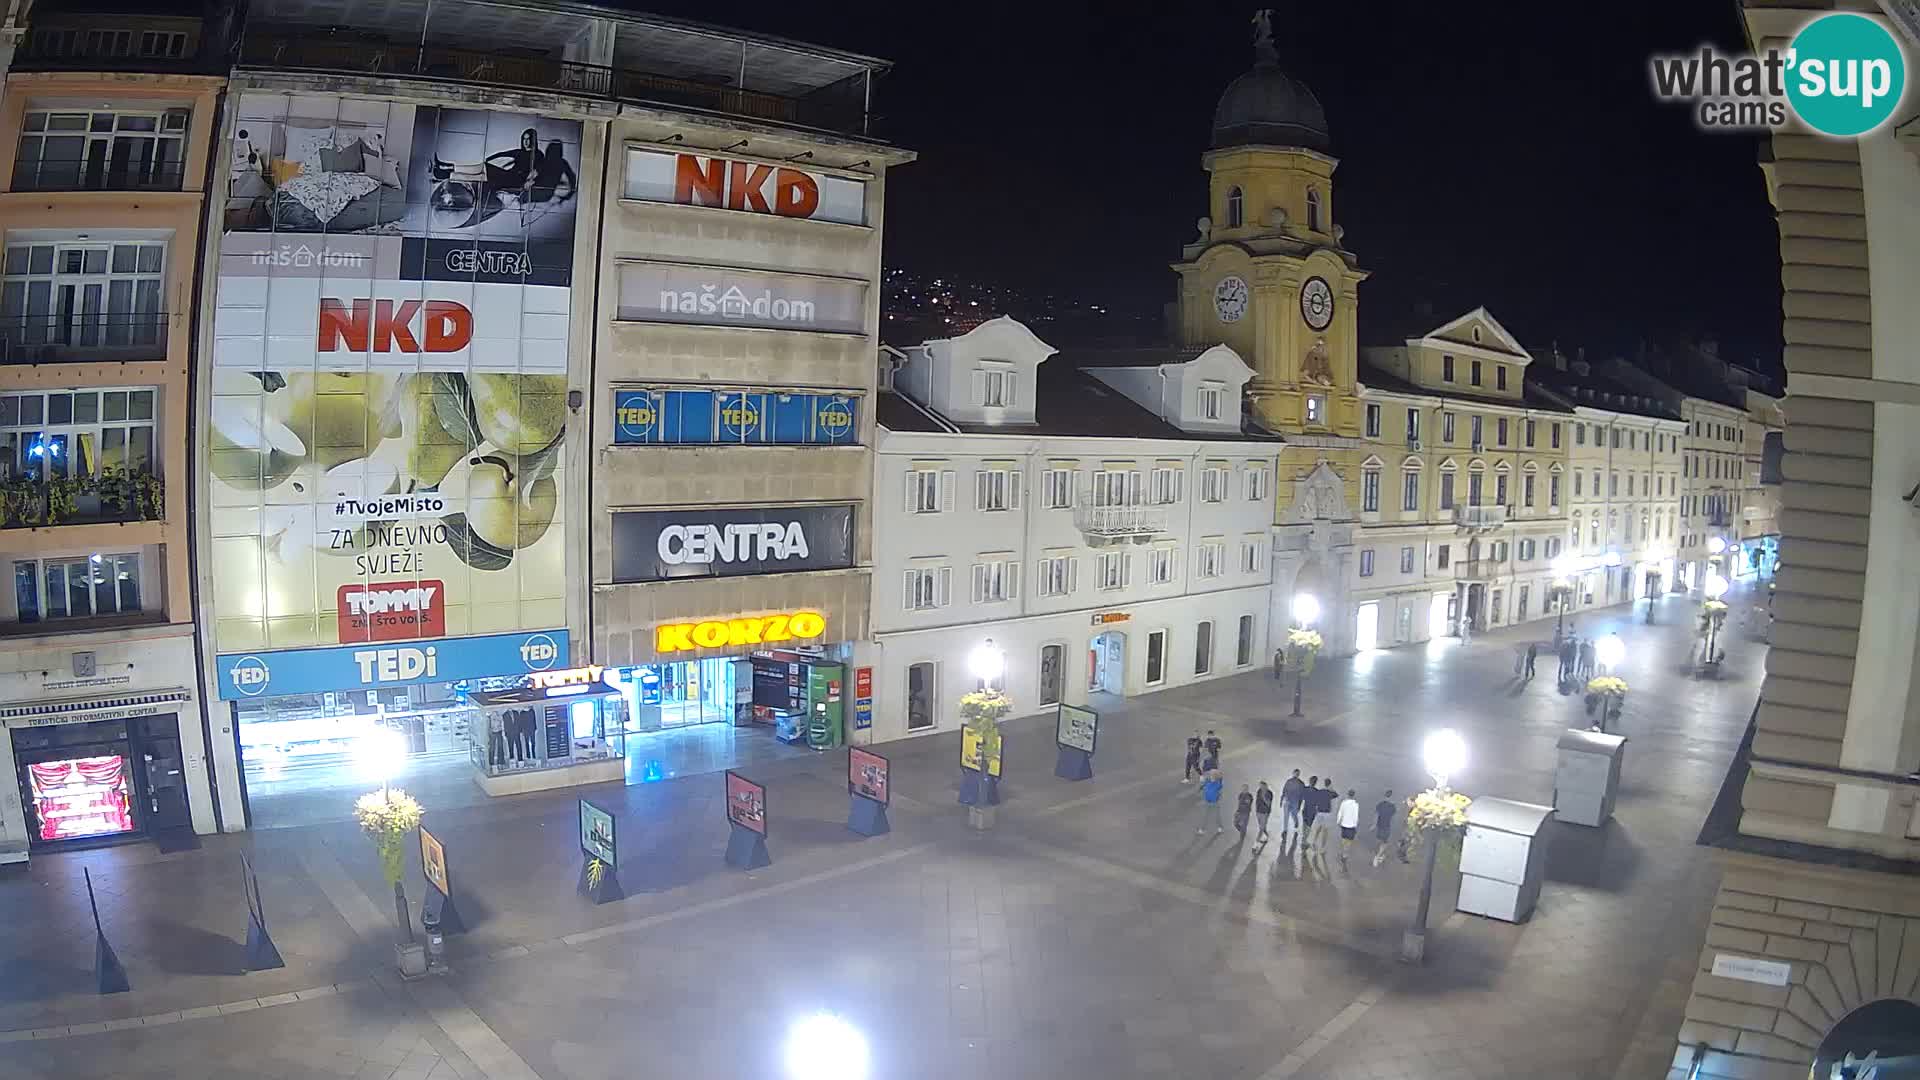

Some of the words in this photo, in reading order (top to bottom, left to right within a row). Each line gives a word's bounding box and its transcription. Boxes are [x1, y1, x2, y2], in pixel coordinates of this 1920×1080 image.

[674, 154, 819, 218] NKD
[251, 245, 292, 267] naš
[318, 245, 363, 268] dom
[445, 249, 533, 276] CENTRA
[660, 284, 717, 315] naš
[752, 290, 815, 321] dom
[318, 298, 474, 352] NKD
[617, 408, 656, 425] TEDi
[722, 409, 759, 426] TEDi
[818, 411, 852, 427] TEDi
[335, 496, 444, 517] #TvojeMisto
[330, 527, 355, 550] ZA
[364, 525, 447, 548] DNEVNO
[657, 521, 809, 565] CENTRA
[356, 548, 424, 576] SVJEŽE
[345, 586, 437, 615] TOMMY
[656, 611, 826, 653] KORZO
[354, 646, 437, 684] TEDi
[520, 643, 558, 661] TEDi
[230, 666, 270, 685] TEDi
[530, 665, 604, 689] TOMMY
